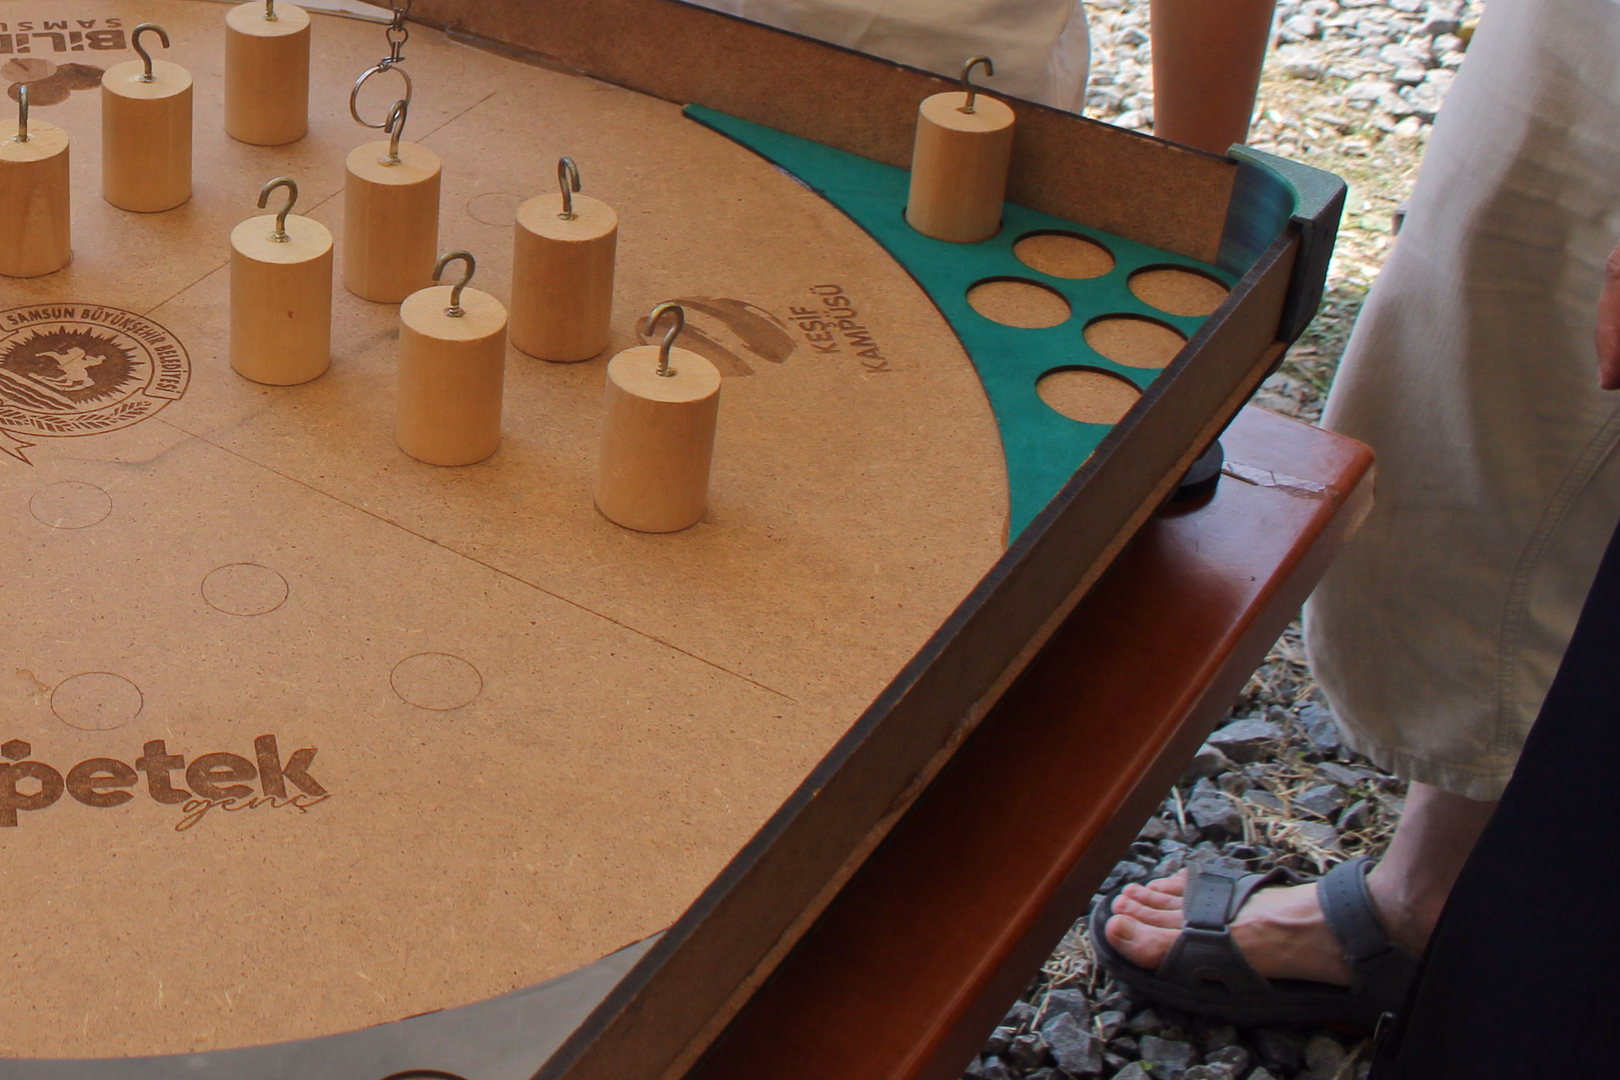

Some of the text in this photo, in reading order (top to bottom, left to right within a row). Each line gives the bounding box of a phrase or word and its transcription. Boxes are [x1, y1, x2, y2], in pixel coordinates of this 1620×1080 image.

[6, 305, 188, 394] SAMSUN BÜYÜKŞEHİR BELEDİYESİ
[788, 306, 842, 354] KEŞİF
[809, 284, 893, 373] KAMPÜSÜ
[174, 793, 332, 832] genç
